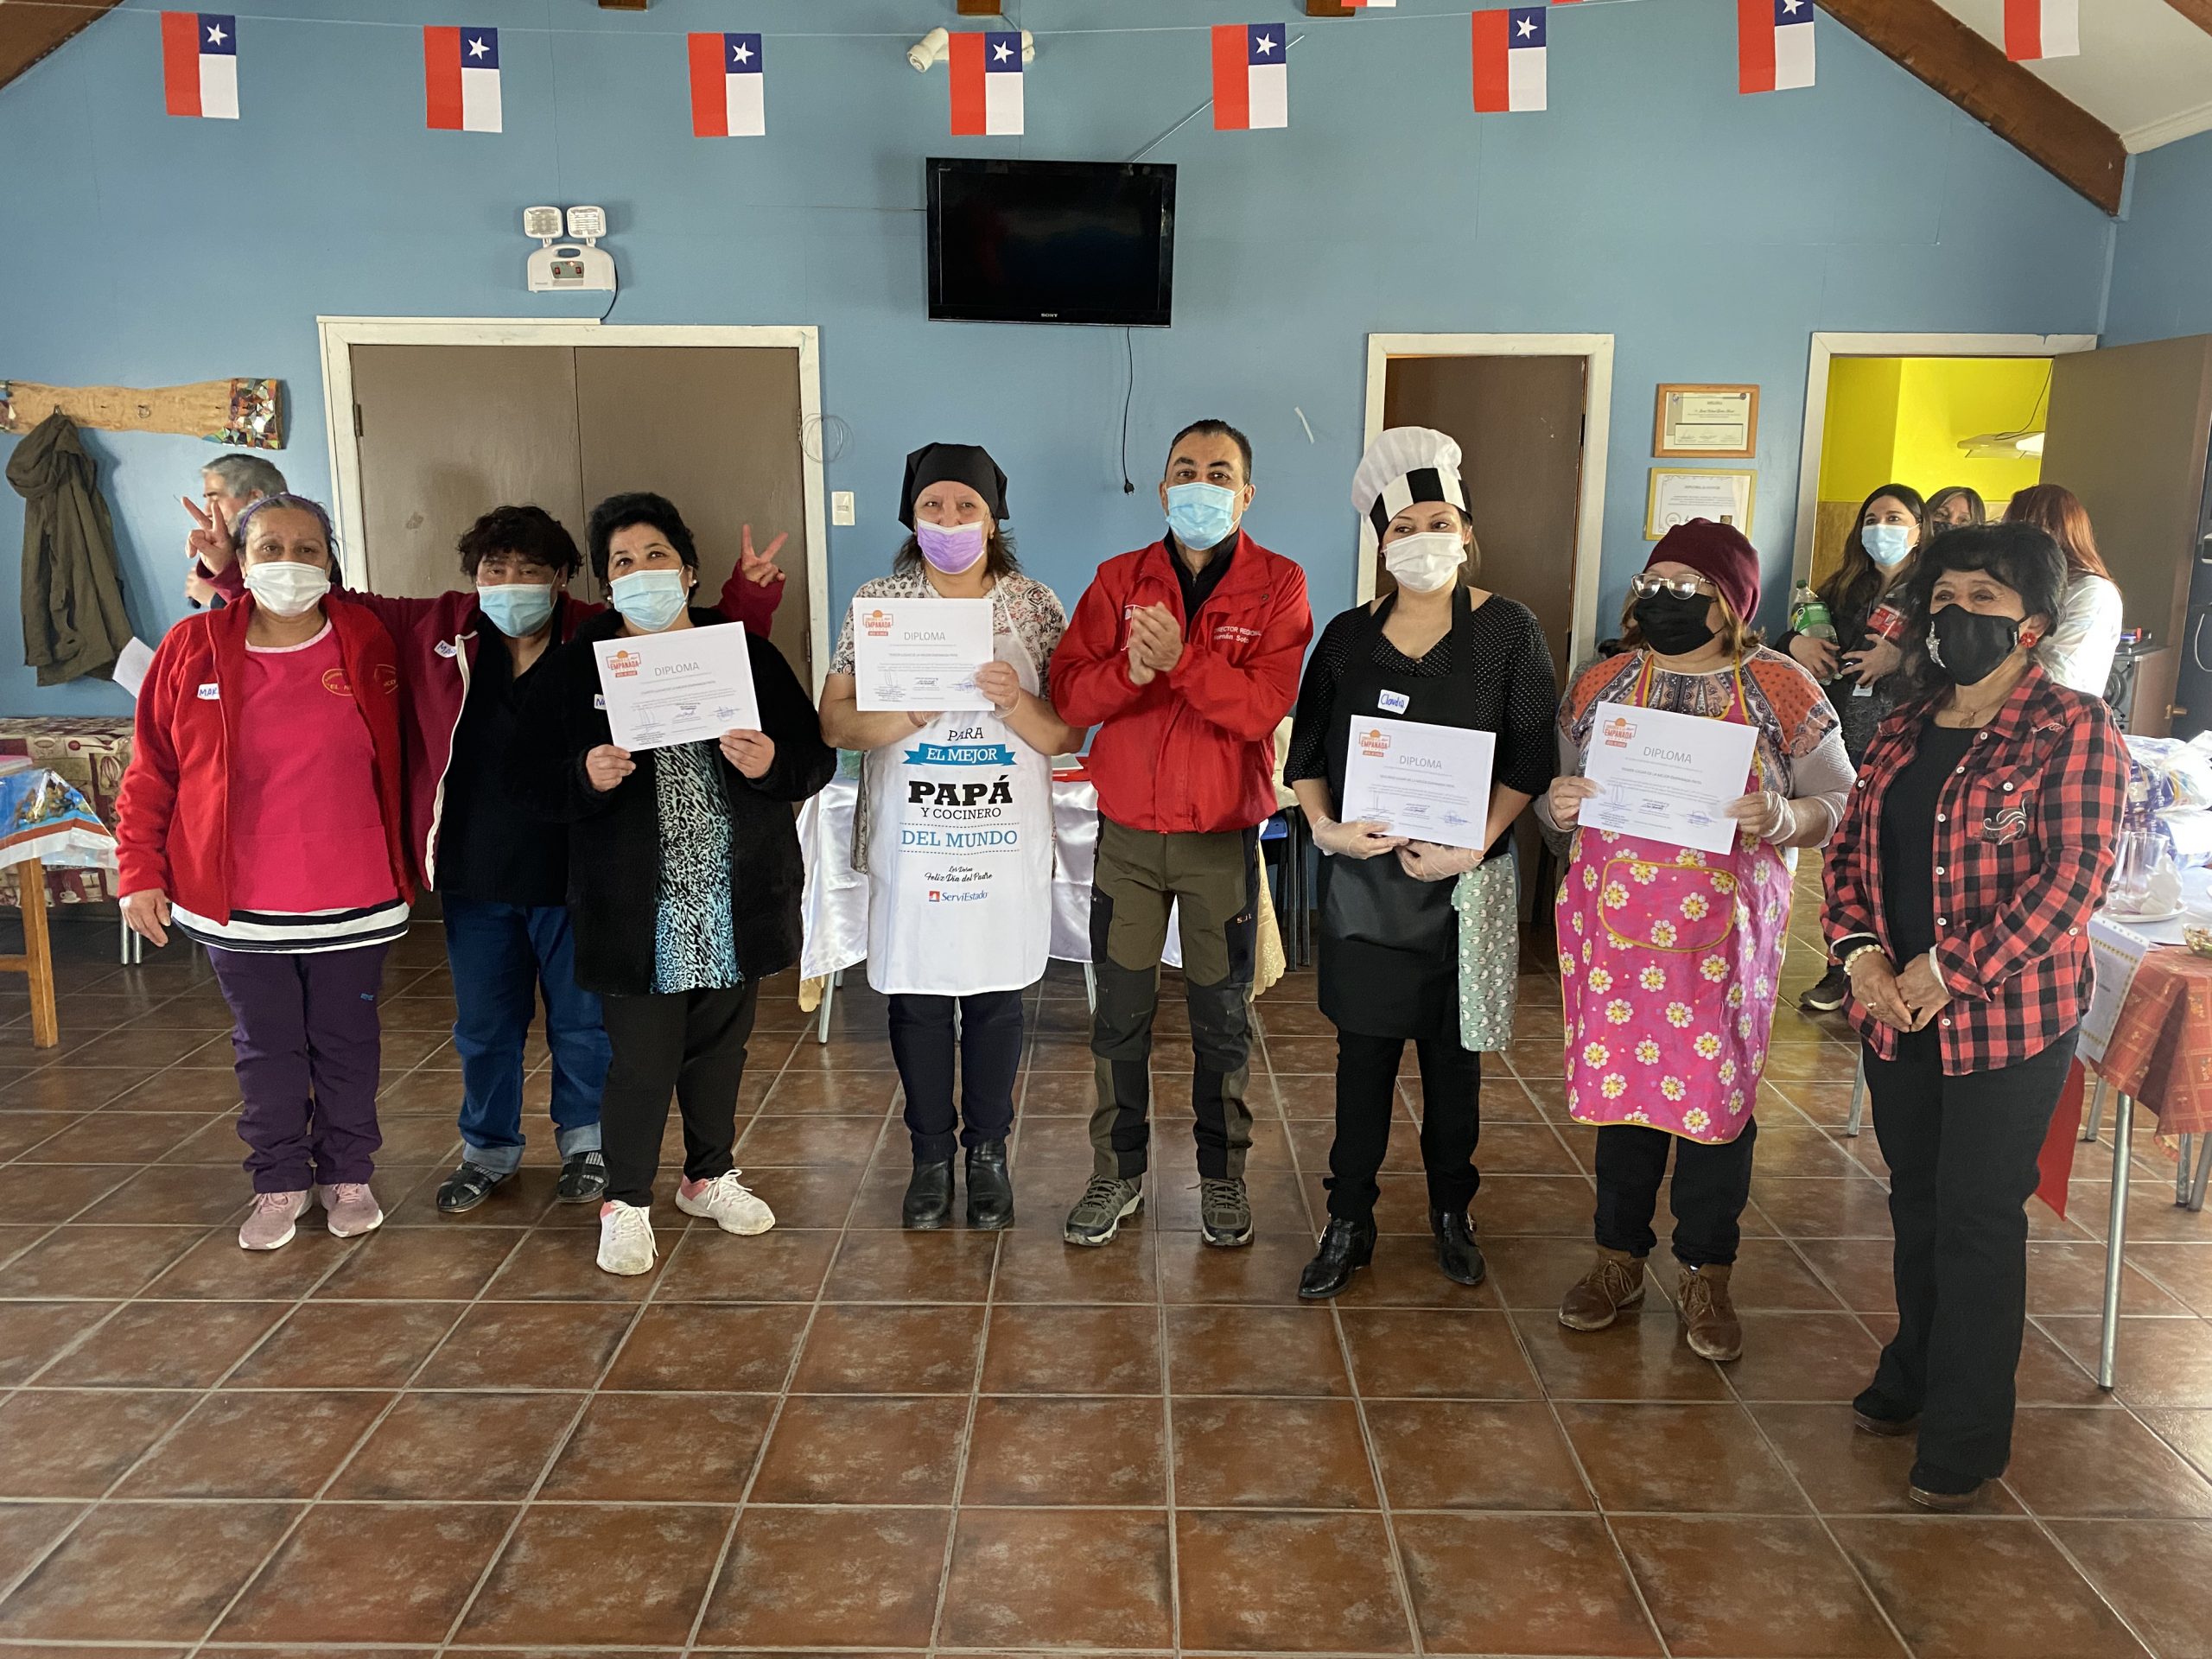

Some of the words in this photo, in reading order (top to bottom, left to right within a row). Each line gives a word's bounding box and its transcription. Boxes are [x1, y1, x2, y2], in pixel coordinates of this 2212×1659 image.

[904, 632, 946, 641] DIPLOMA
[654, 662, 700, 677] DIPLOMA
[947, 728, 984, 741] PARA
[926, 748, 944, 761] EL
[948, 748, 998, 763] MEJOR
[1399, 755, 1442, 770] DIPLOMA
[1643, 747, 1693, 764] DIPLOMA
[908, 775, 1014, 806] PAPÁ
[921, 807, 931, 817] Y
[933, 807, 1001, 820] COCINERO
[901, 830, 940, 846] DEL
[945, 830, 1018, 848] MUNDO
[925, 872, 944, 881] Feliz
[974, 872, 993, 881] Padre
[941, 890, 988, 901] ServiEstado
